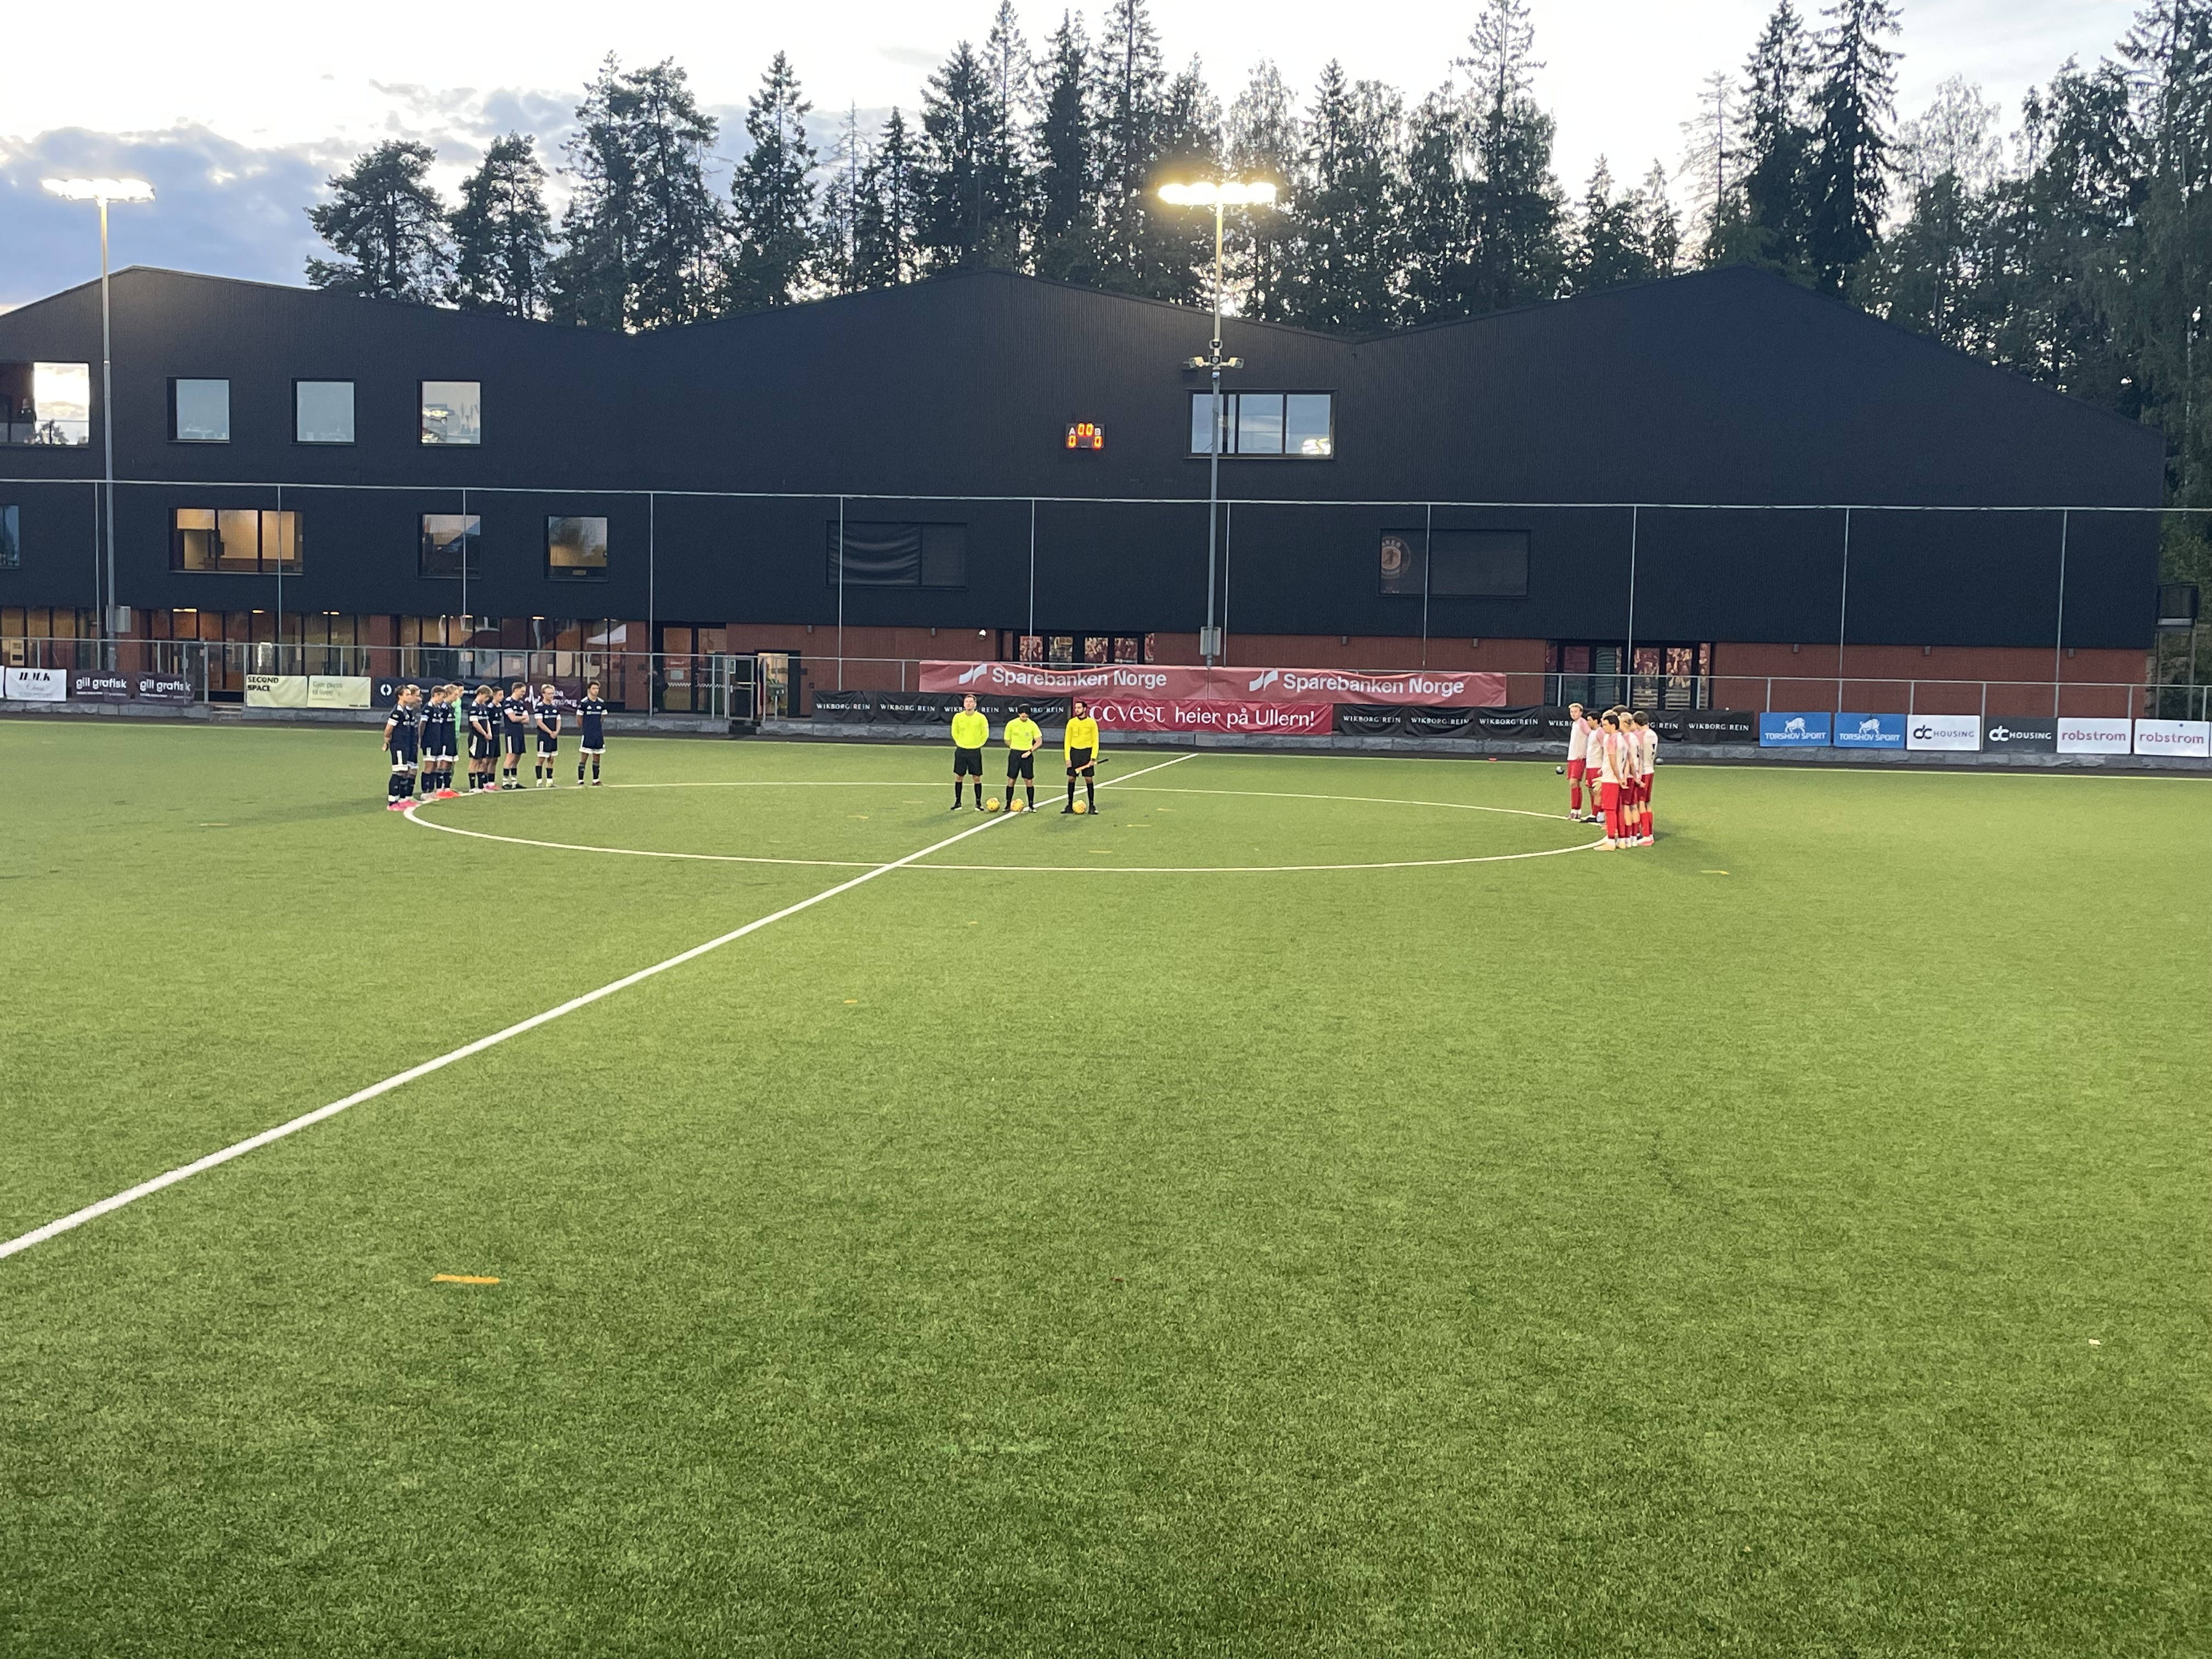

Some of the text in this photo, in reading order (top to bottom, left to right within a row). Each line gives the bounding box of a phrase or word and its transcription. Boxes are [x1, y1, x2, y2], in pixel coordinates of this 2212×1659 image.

[1069, 427, 1076, 435] A
[991, 667, 1167, 690] Sparebanken Norge
[92, 678, 127, 690] grafisk
[1283, 673, 1465, 697] Sparebanken Norge
[880, 703, 915, 712] WIKBORG
[1175, 706, 1221, 724] heier
[1227, 707, 1248, 729] på
[1255, 709, 1314, 727] Ullern!
[1342, 715, 1379, 723] WIKBORG
[1764, 732, 1801, 740] TORSHOV
[1839, 732, 1900, 741] TORSHOV SPORT
[2009, 731, 2052, 740] HOUSING
